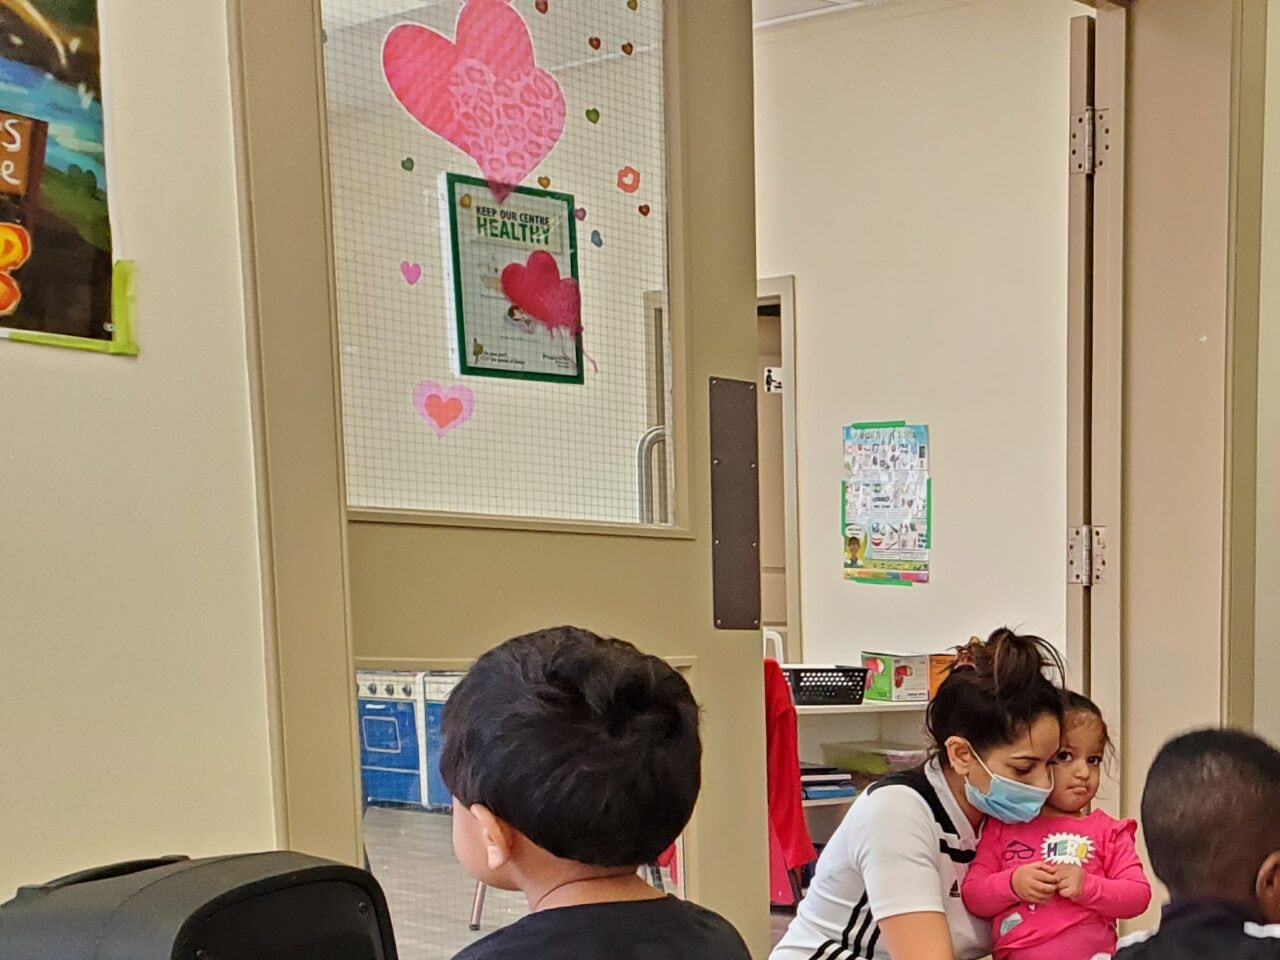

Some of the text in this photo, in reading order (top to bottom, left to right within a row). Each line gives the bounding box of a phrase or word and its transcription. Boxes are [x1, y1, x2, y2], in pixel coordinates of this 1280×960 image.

[476, 205, 550, 225] KEEP OUR CENTRE
[476, 216, 551, 245] HEALTHY
[1047, 839, 1088, 860] HERO
